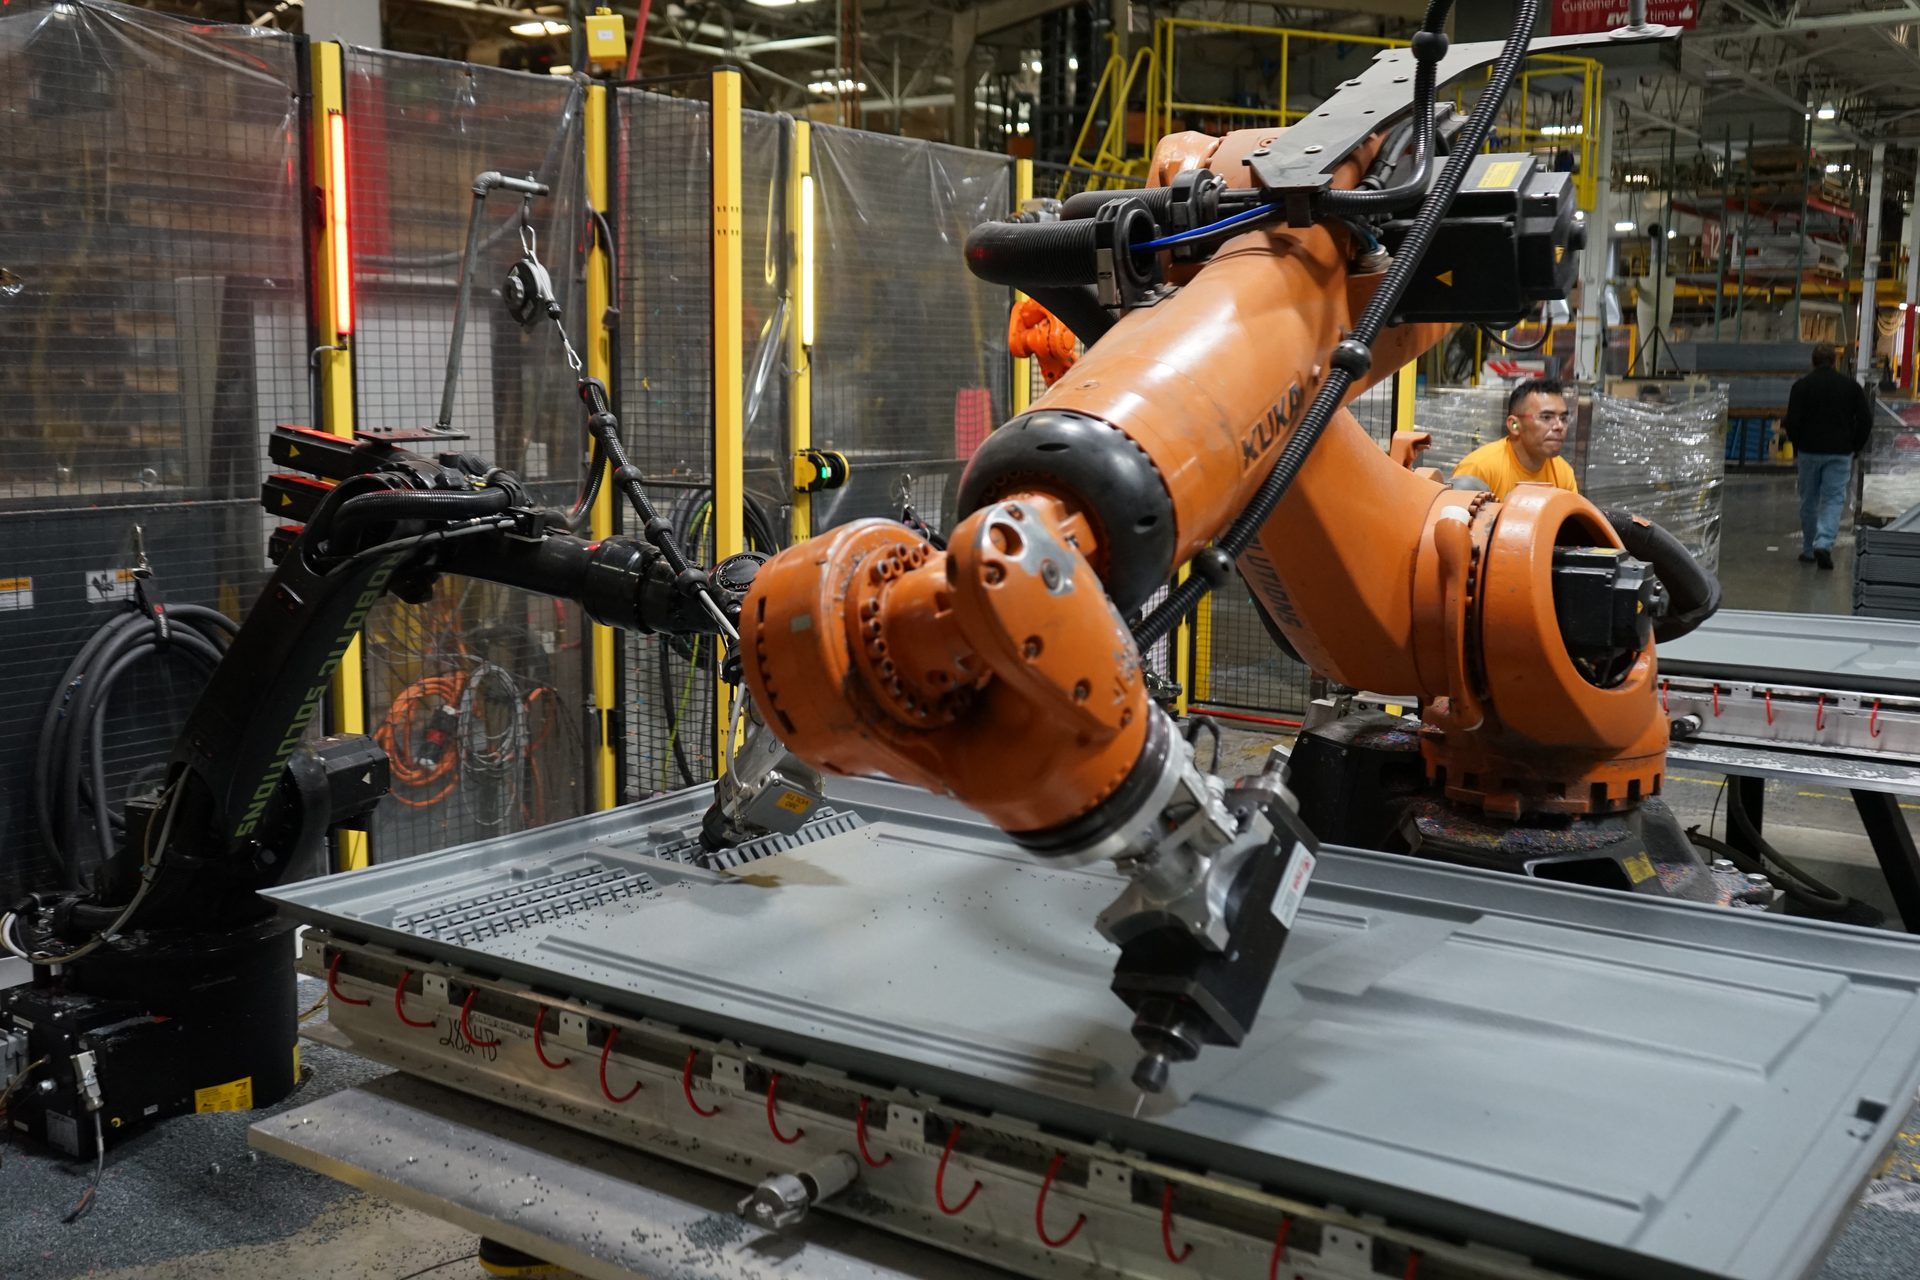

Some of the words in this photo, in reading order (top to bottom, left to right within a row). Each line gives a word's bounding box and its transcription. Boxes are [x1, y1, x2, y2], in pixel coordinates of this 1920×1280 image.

[1562, 0, 1615, 13] Customer
[1651, 9, 1676, 22] time
[1241, 382, 1304, 470] KUKA
[317, 550, 403, 677] ROBOTIC
[235, 684, 326, 838] SOLUTIONS
